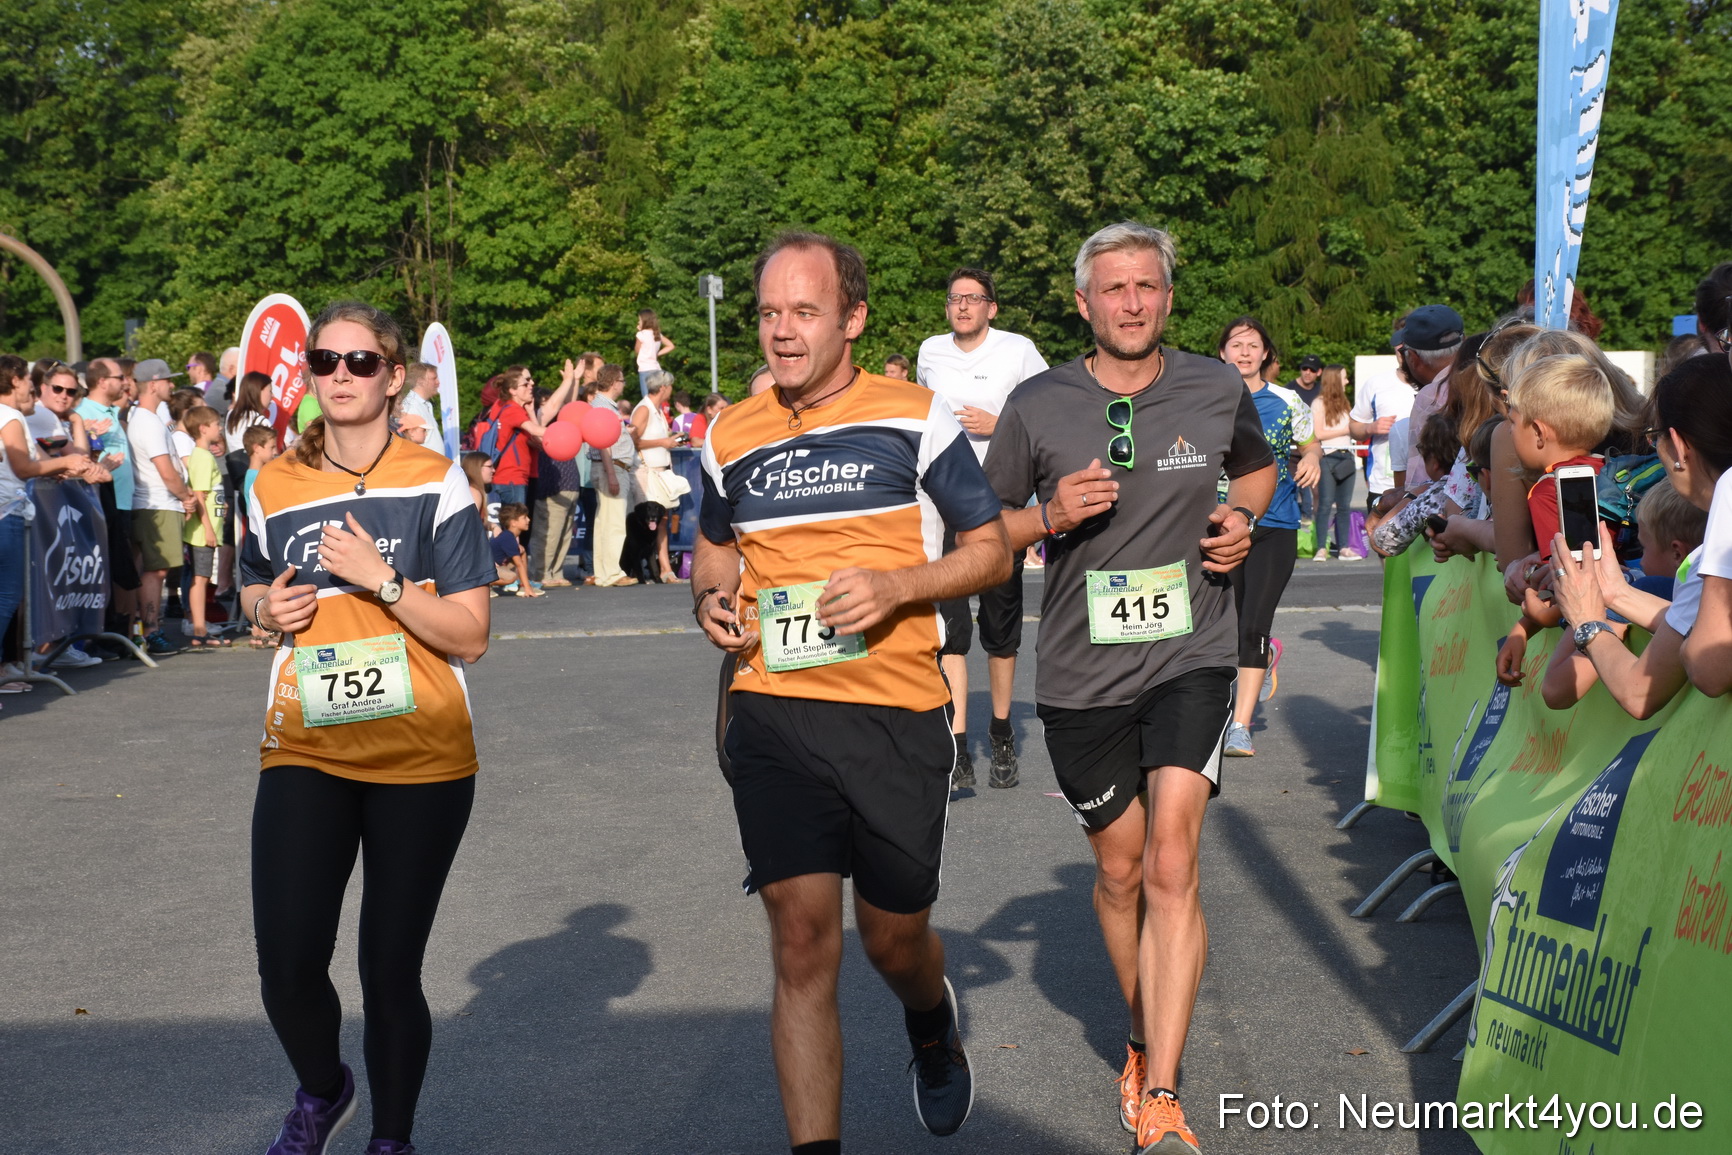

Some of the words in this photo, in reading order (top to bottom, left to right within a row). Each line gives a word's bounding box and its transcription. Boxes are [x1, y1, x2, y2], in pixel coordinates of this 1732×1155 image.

[259, 316, 276, 345] AVIA
[1157, 455, 1207, 467] BURKHARDT
[764, 460, 874, 489] Fischer
[773, 482, 865, 501] AUTOMOBILE
[1166, 582, 1183, 591] 2019
[1111, 593, 1170, 622] 415
[1122, 623, 1143, 631] Heim
[796, 651, 827, 660] Automobile
[803, 642, 837, 653] Stephan
[379, 656, 400, 665] 2019
[320, 667, 385, 702] 752
[331, 701, 349, 710] Graf
[351, 698, 382, 707] Andrea
[343, 706, 375, 715] Automobile
[376, 703, 395, 711] GmbH
[1576, 784, 1618, 818] Fischer
[1570, 821, 1605, 840] AUTOMOBILE
[1497, 891, 1653, 1047] firmenlauf
[1486, 1018, 1548, 1071] neumarkt
